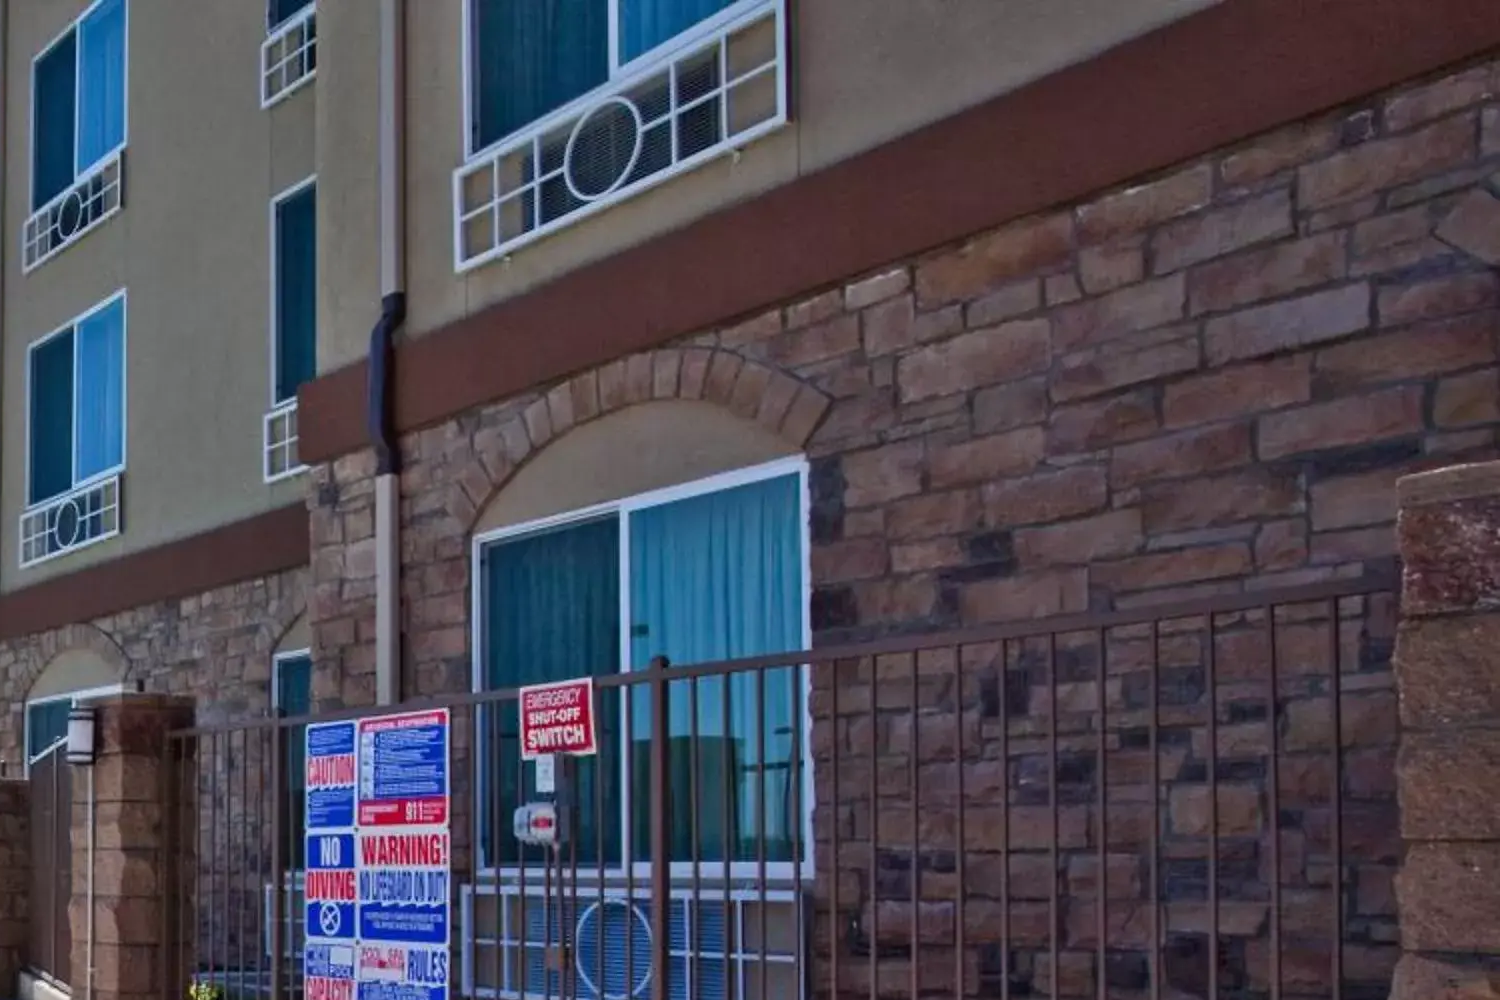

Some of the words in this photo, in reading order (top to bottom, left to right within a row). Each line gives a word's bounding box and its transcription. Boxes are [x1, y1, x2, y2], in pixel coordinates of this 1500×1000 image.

[527, 688, 581, 709] EMERGENCY
[528, 707, 581, 725] SHUT-OFF
[527, 724, 585, 749] SWITCH
[308, 754, 354, 787] CAUTION
[405, 802, 423, 822] 911
[320, 837, 341, 866] NO
[361, 834, 447, 866] WARNING!
[307, 869, 356, 900] DIVING
[407, 949, 447, 983] RULES
